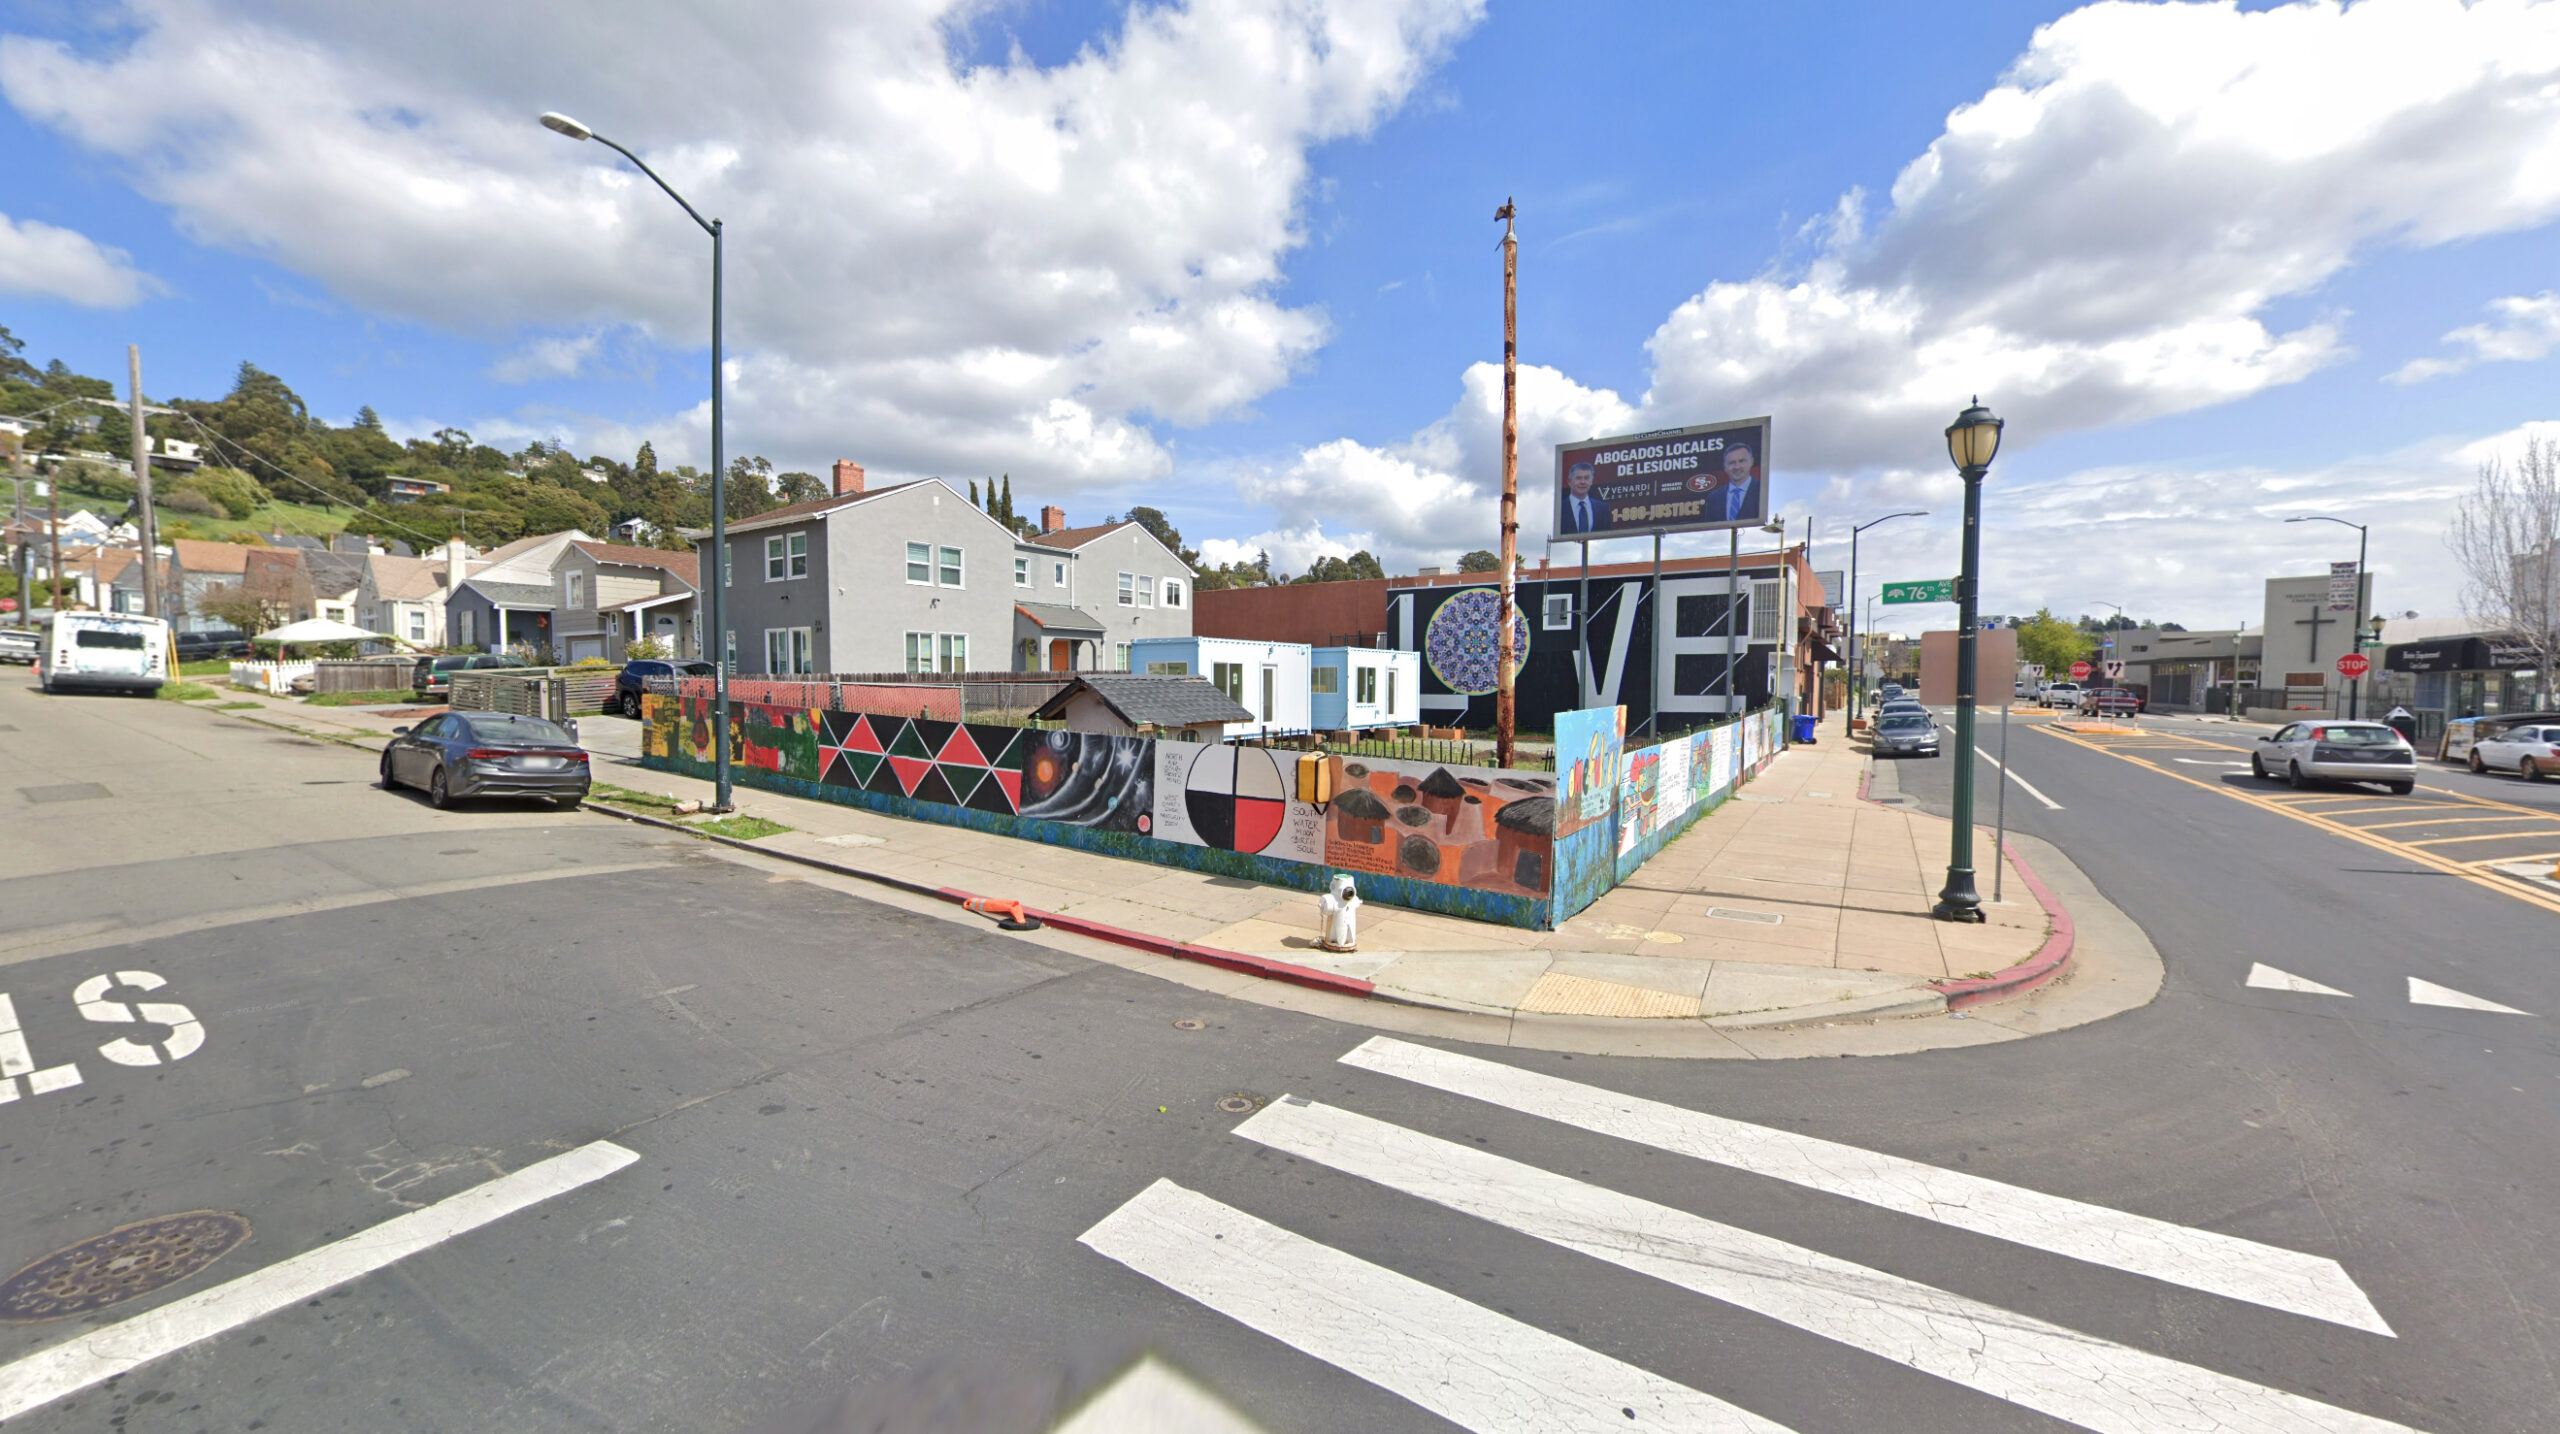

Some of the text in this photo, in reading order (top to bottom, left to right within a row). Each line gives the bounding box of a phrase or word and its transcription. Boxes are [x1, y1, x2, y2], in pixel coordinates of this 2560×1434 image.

[1594, 437, 1724, 465] ABOGADOS LOCALES
[1617, 456, 1698, 477] DE LESIONES
[1611, 483, 1650, 494] VENARDI
[1938, 579, 1952, 588] AVE
[2338, 660, 2367, 671] STOP
[1293, 820, 1320, 832] WATER
